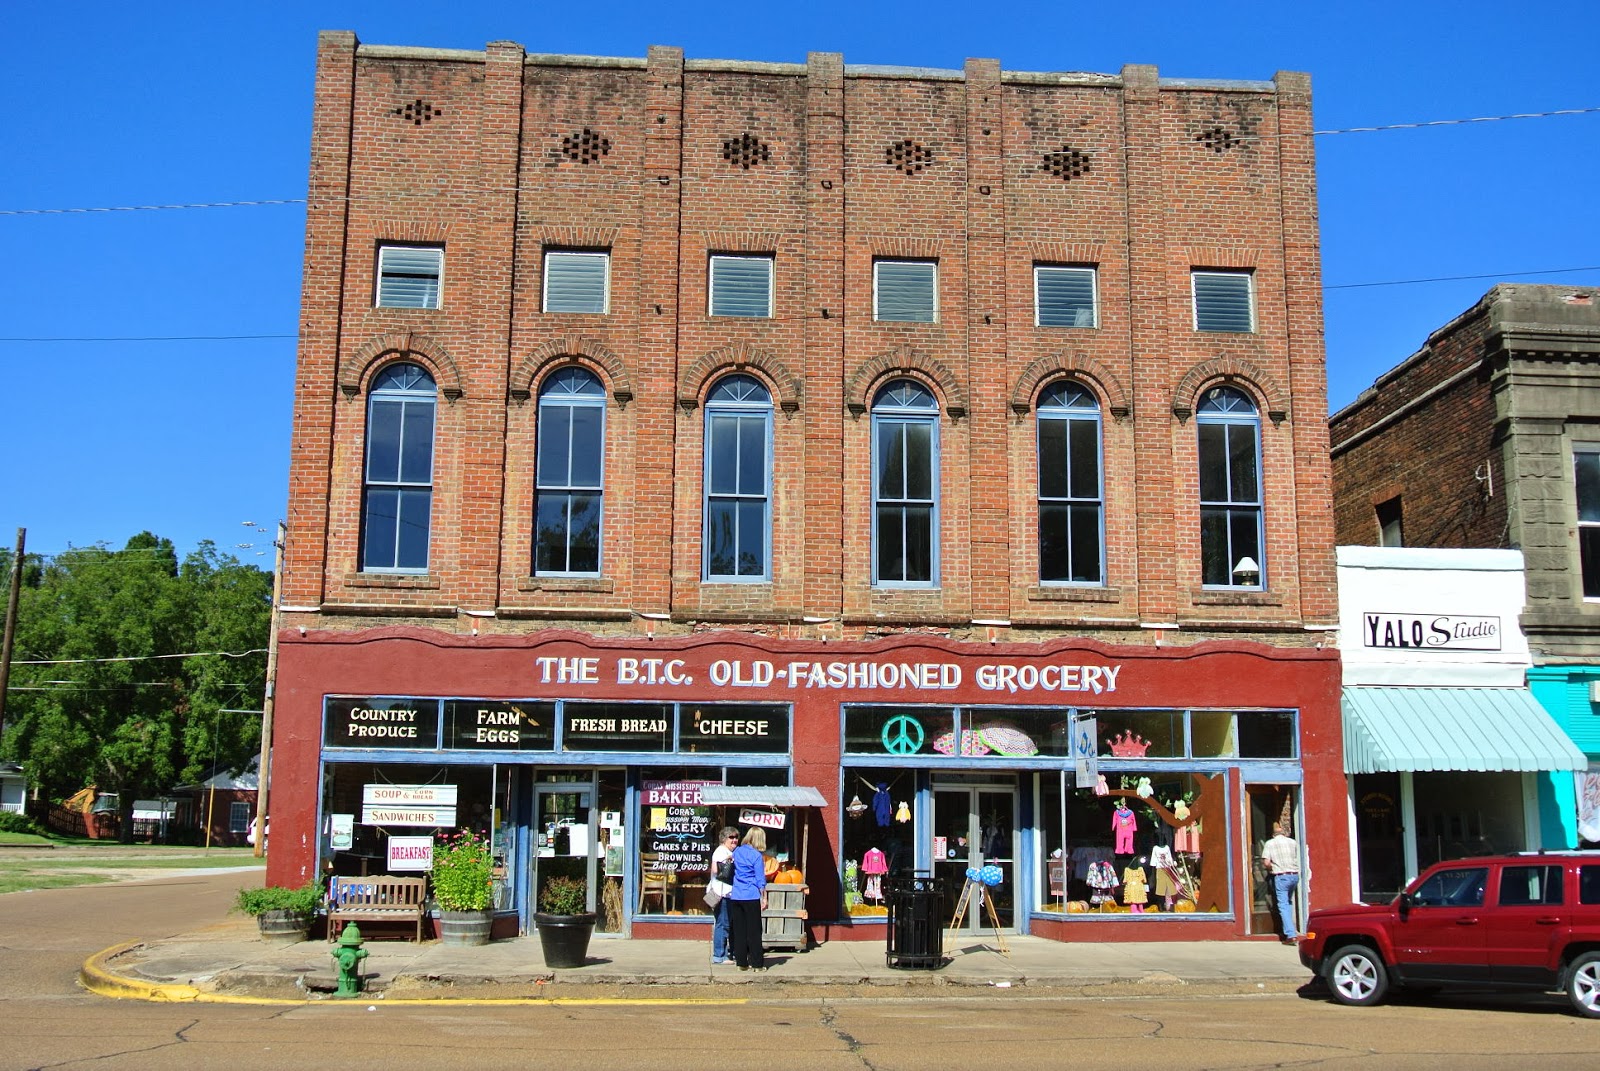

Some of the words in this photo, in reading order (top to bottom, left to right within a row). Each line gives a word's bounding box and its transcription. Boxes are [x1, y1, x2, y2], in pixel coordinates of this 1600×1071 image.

[1367, 615, 1423, 647] YALO
[1426, 617, 1498, 646] Studio
[536, 656, 600, 684] THE
[617, 658, 693, 686] B.T.C.
[709, 660, 963, 690] OLD-FASHIONED
[975, 664, 1122, 695] GROCERY
[350, 707, 418, 722] COUNTRY
[477, 709, 521, 726] FARM
[348, 723, 418, 738] PRODUCE
[571, 718, 617, 732] FRESH
[621, 719, 668, 733] BREAD
[699, 720, 769, 736] CHEESE
[476, 727, 520, 743] EGGS
[374, 789, 402, 799] SOUP
[403, 791, 409, 799] &
[649, 790, 704, 805] BAKER
[372, 810, 435, 822] SANDWICHES
[668, 806, 696, 817] CORA'S
[742, 810, 783, 827] CORN
[391, 846, 431, 860] BREAKFAST
[652, 841, 680, 852] CAKES
[681, 842, 690, 851] &
[691, 841, 711, 852] PIES
[658, 852, 702, 862] BROWNIES
[652, 861, 679, 871] BAKED
[680, 861, 709, 872] GOODS
